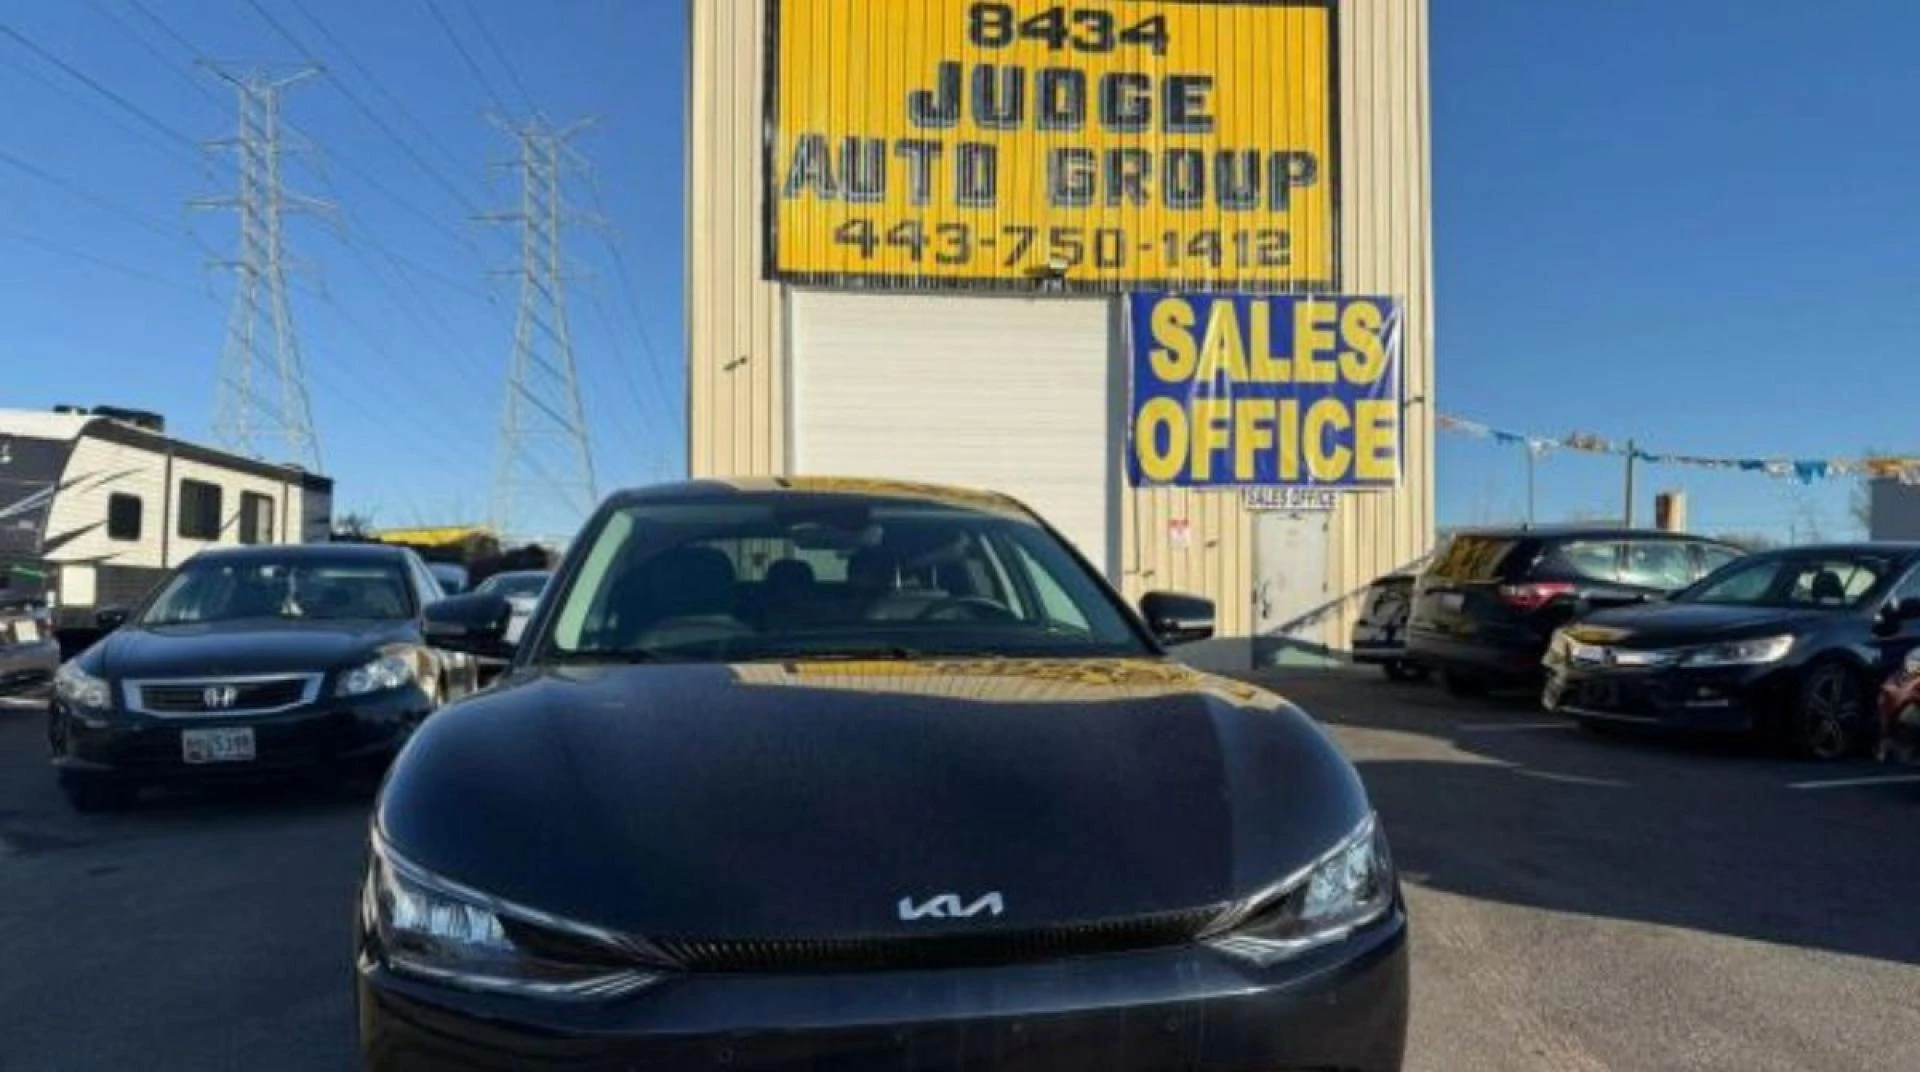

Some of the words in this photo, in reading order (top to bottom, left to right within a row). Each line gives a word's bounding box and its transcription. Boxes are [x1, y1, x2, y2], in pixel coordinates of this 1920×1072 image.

[970, 2, 1167, 55] 8434
[909, 61, 1214, 133] JUDGE
[784, 135, 996, 206] AUTO
[1047, 148, 1317, 211] GROUP
[835, 218, 1291, 267] 443-750-1412
[1150, 298, 1384, 383] SALES
[1136, 397, 1395, 481] OFFICE
[1247, 488, 1286, 507] SALES
[1290, 489, 1336, 506] OFFICE
[899, 891, 1003, 920] KIA
